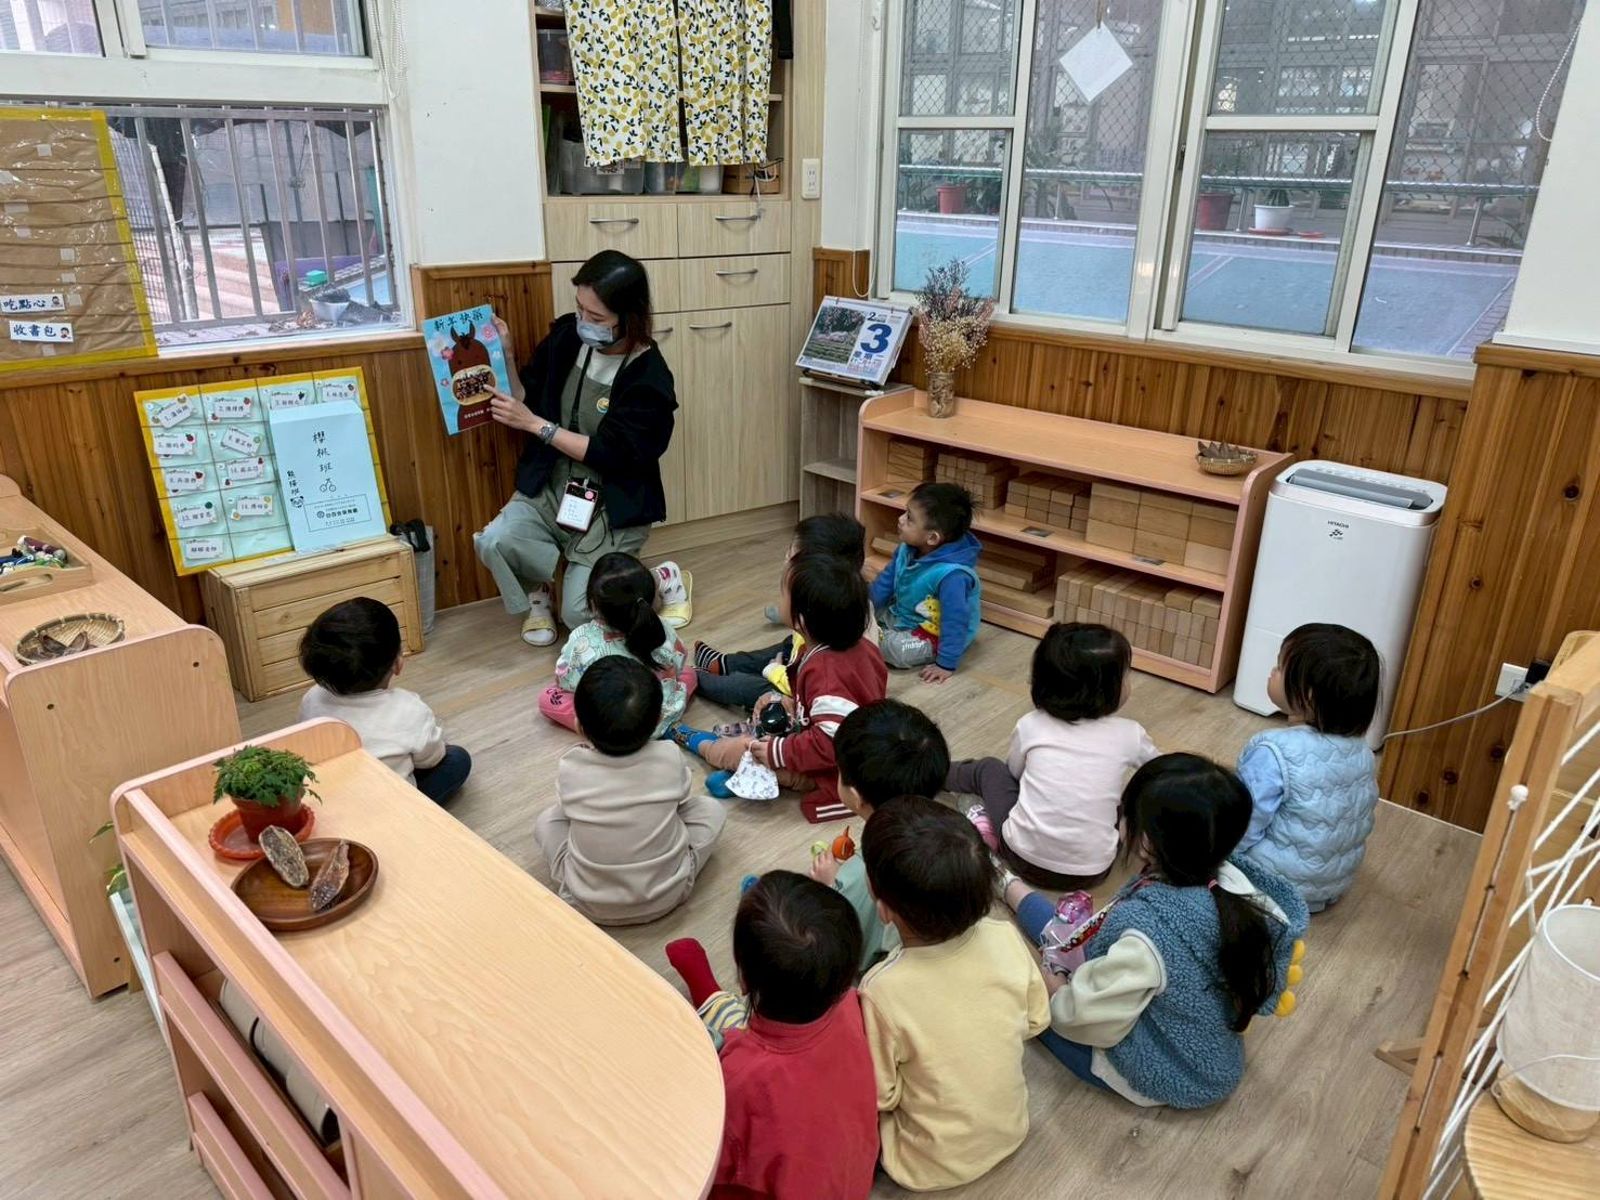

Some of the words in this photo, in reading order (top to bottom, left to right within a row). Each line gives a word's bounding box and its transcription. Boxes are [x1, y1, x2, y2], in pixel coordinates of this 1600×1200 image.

[3, 298, 46, 311] 吃點心
[867, 312, 876, 321] 2
[13, 324, 57, 337] 收書包
[860, 323, 892, 354] 3
[312, 430, 334, 475] 櫻桃班
[1327, 520, 1349, 528] HITACHI
